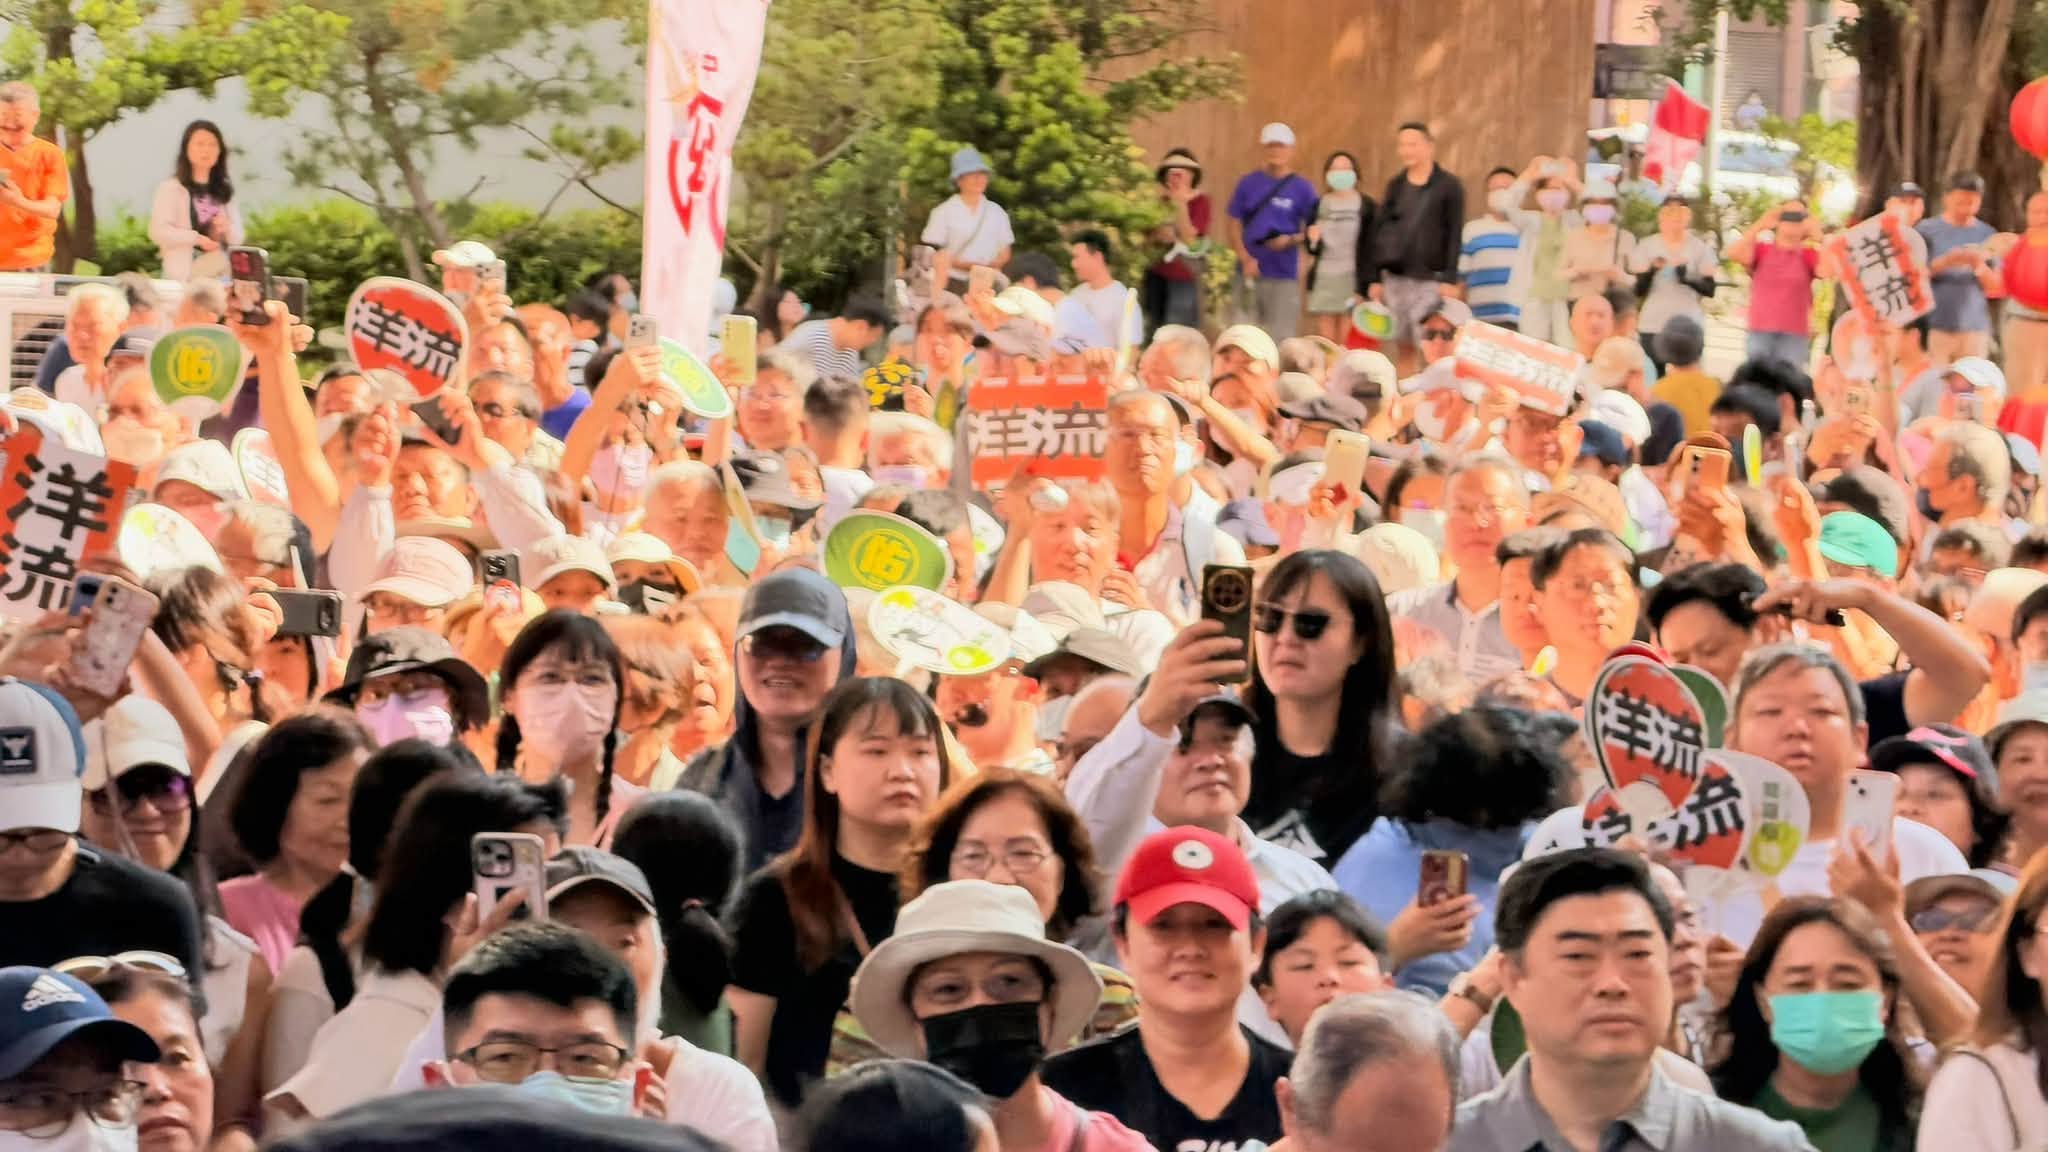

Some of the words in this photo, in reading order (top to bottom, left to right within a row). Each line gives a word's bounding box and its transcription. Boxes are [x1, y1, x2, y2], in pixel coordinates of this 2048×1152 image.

[352, 296, 462, 381] 洋流
[968, 401, 1107, 460] 洋流
[0, 453, 113, 609] 洋流
[1600, 686, 1704, 781] 洋流
